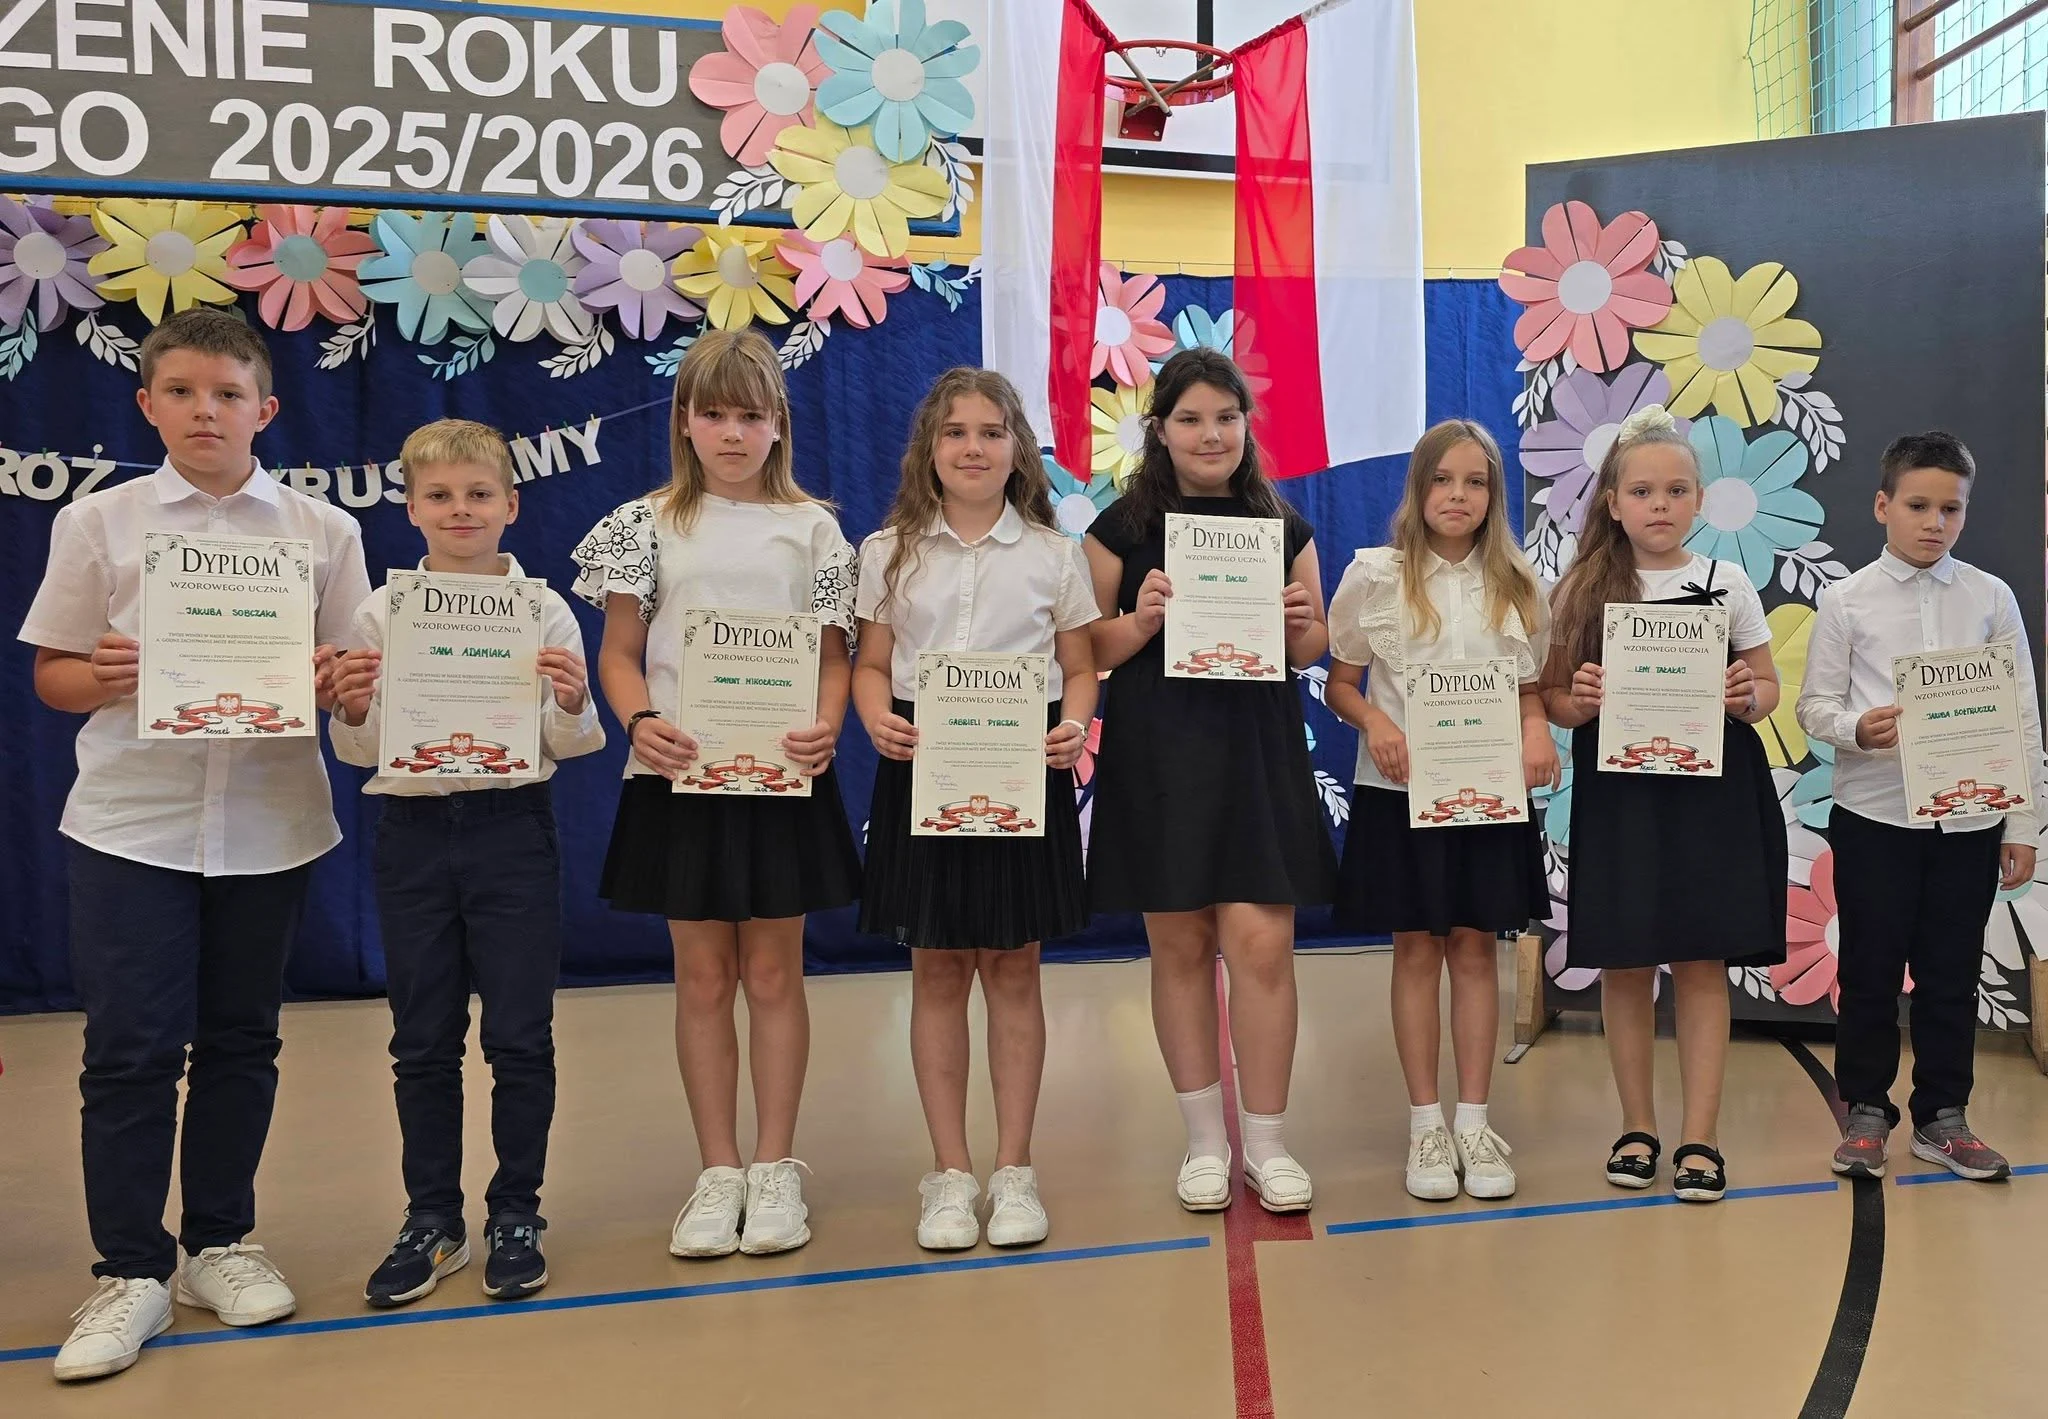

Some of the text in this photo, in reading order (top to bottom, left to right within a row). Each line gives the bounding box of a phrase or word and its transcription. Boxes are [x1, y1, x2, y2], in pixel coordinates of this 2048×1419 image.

[374, 7, 678, 104] ROKU
[0, 87, 704, 202] GO 2025/2026
[1192, 527, 1260, 550] DYPLOM
[181, 547, 281, 577] DYPLOM
[1185, 554, 1267, 564] WZOROWEGO UCZNIA
[170, 581, 290, 594] WZOROWEGO UCZNIA
[423, 588, 515, 617] DYPLOM
[185, 607, 277, 618] JAKUBA SOBCZAKA
[412, 621, 522, 634] WZOROWEGO UCZNIA
[1632, 617, 1704, 640] DYPLOM
[713, 622, 794, 649] DYPLOM
[430, 646, 511, 658] JANA ADAMIAKA
[1623, 645, 1709, 654] WZOROWEGO UCZNIA
[703, 653, 799, 665] WZOROWEGO UCZNIA
[1635, 665, 1650, 673] LENY
[1921, 660, 1993, 687] DYPLOM
[946, 665, 1022, 690] DYPLOM
[1430, 673, 1496, 694] DYPLOM
[1914, 684, 2001, 701] WZOROWEGO UCZNIA
[936, 695, 1029, 705] WZOROWEGO UCZNIA
[1423, 699, 1473, 707] WZOROWEGO
[948, 718, 981, 726] GABRIELI
[1437, 719, 1456, 727] ADELI
